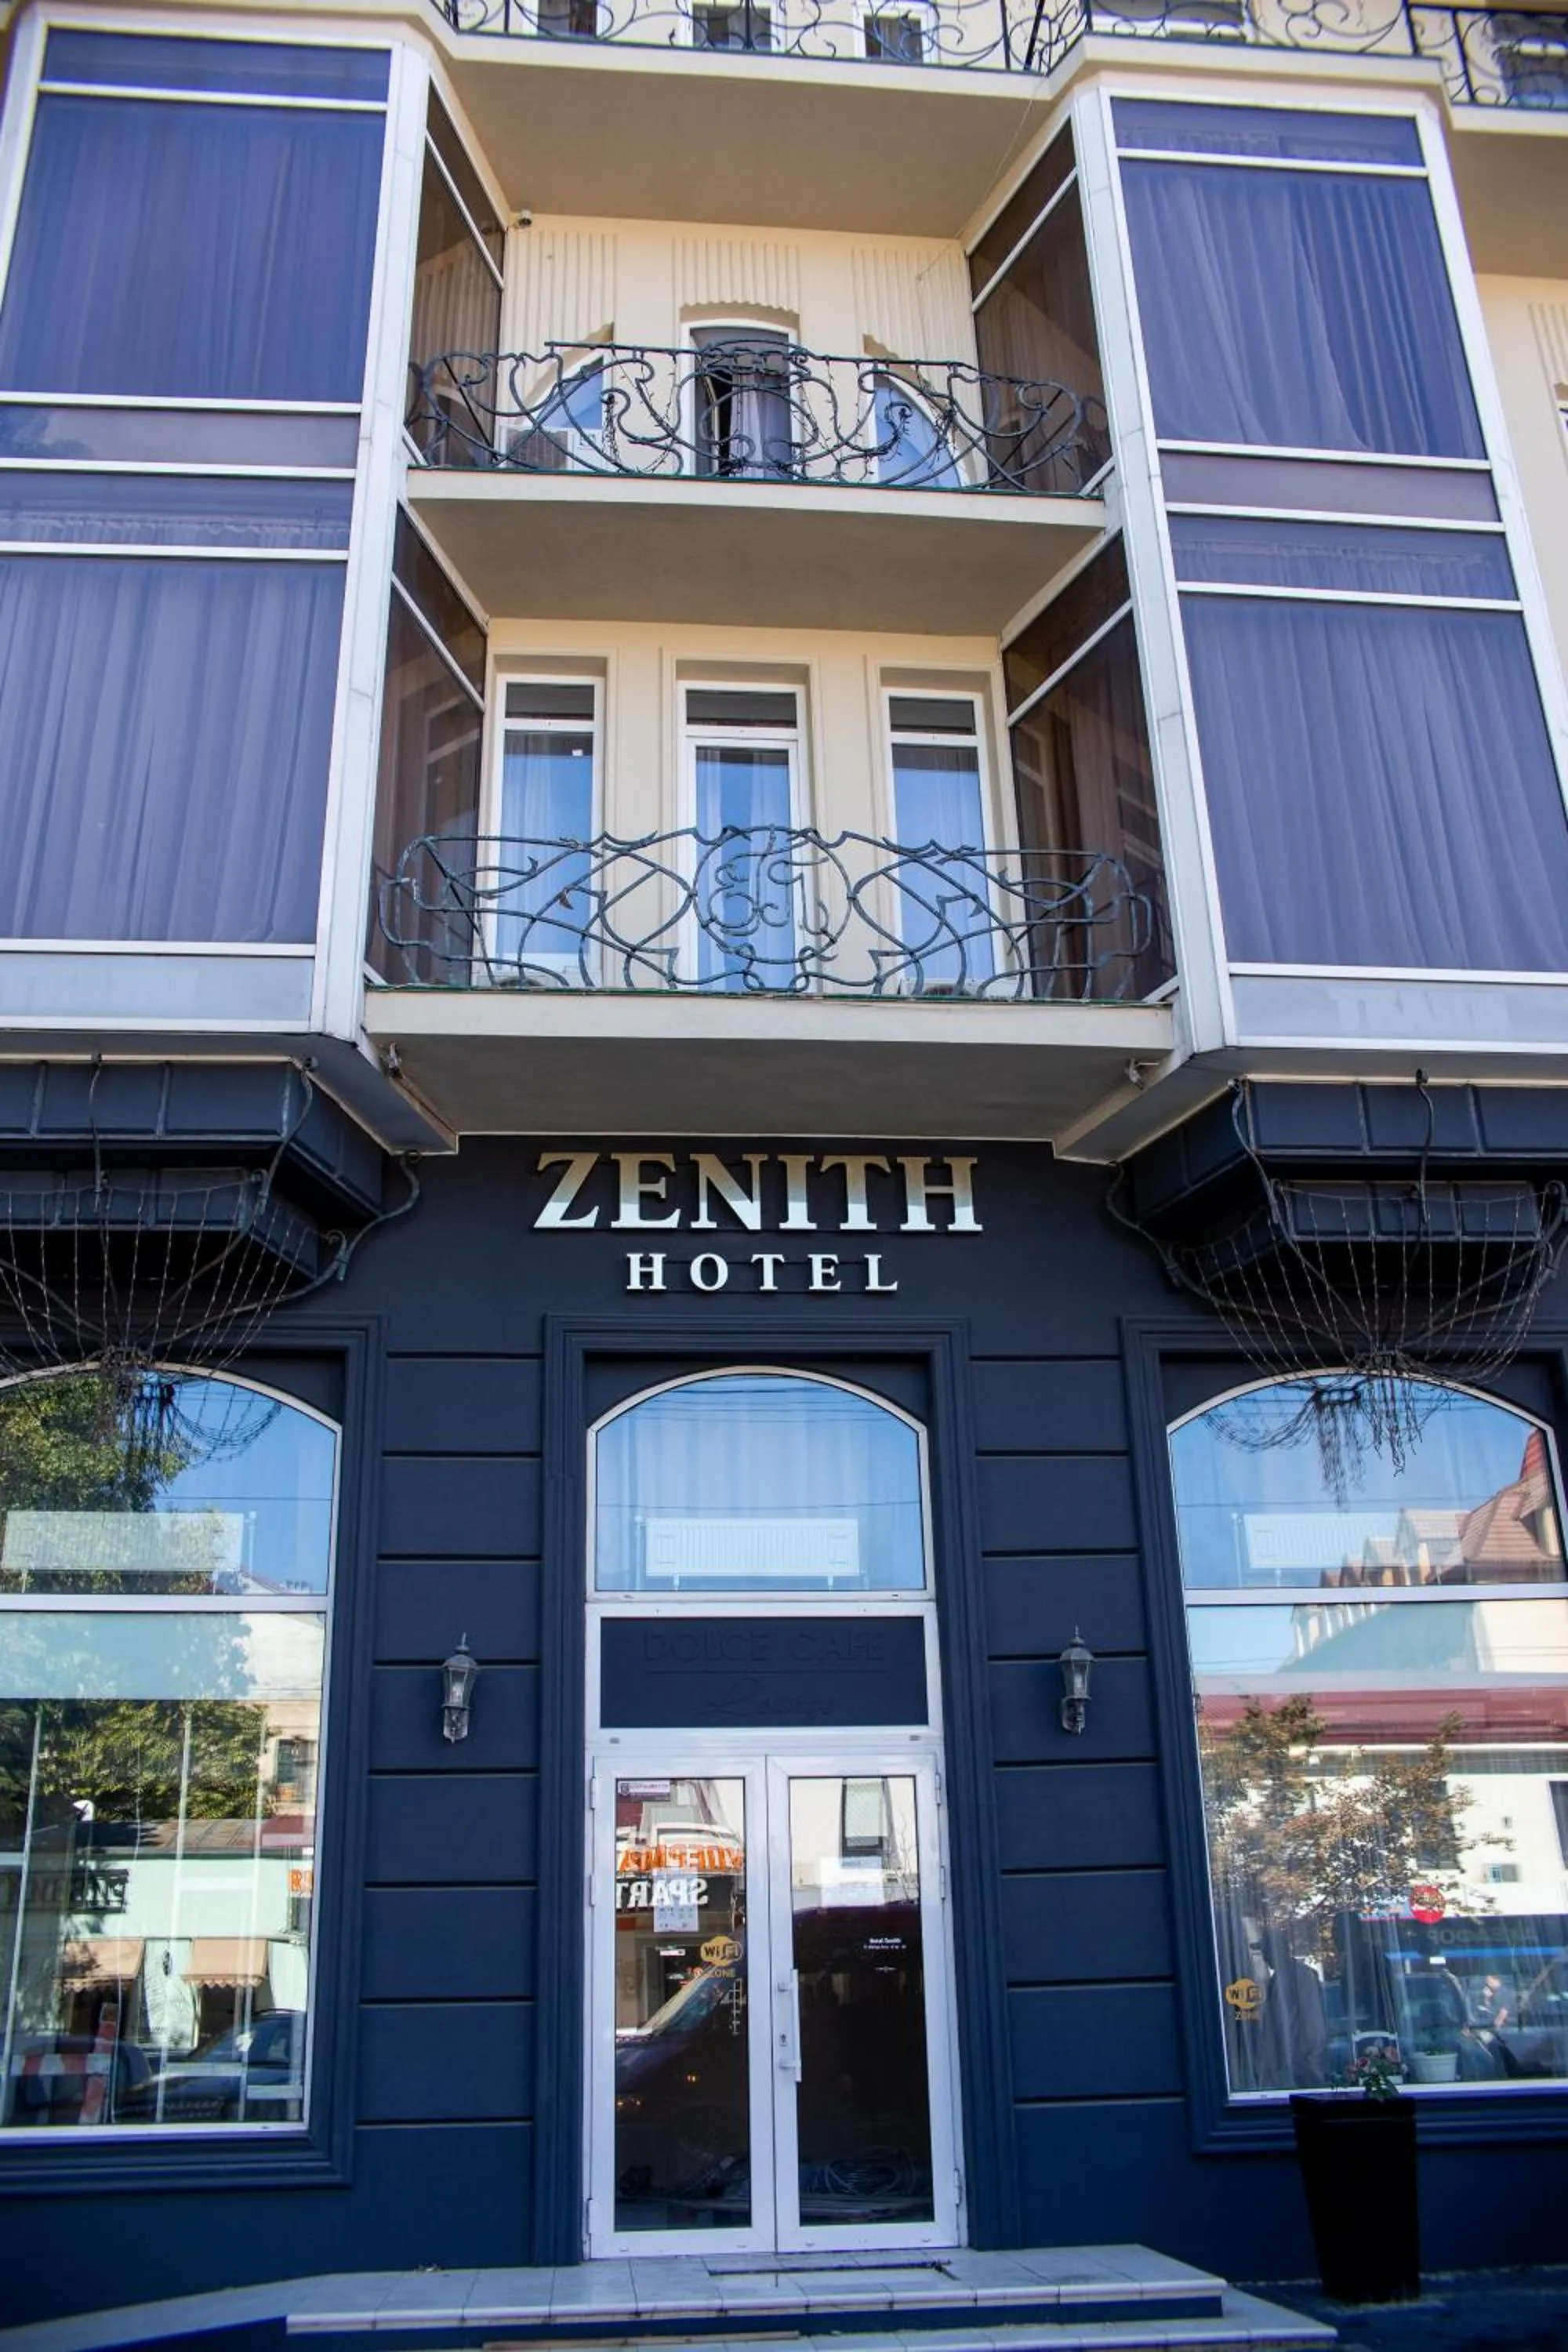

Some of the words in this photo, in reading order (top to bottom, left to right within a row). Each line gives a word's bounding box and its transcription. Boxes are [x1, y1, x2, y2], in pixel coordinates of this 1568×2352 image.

[534, 1152, 983, 1231] ZENITH
[626, 1253, 898, 1291] HOTEL
[644, 1629, 771, 1661] DOLCE
[788, 1629, 886, 1661] CAFE
